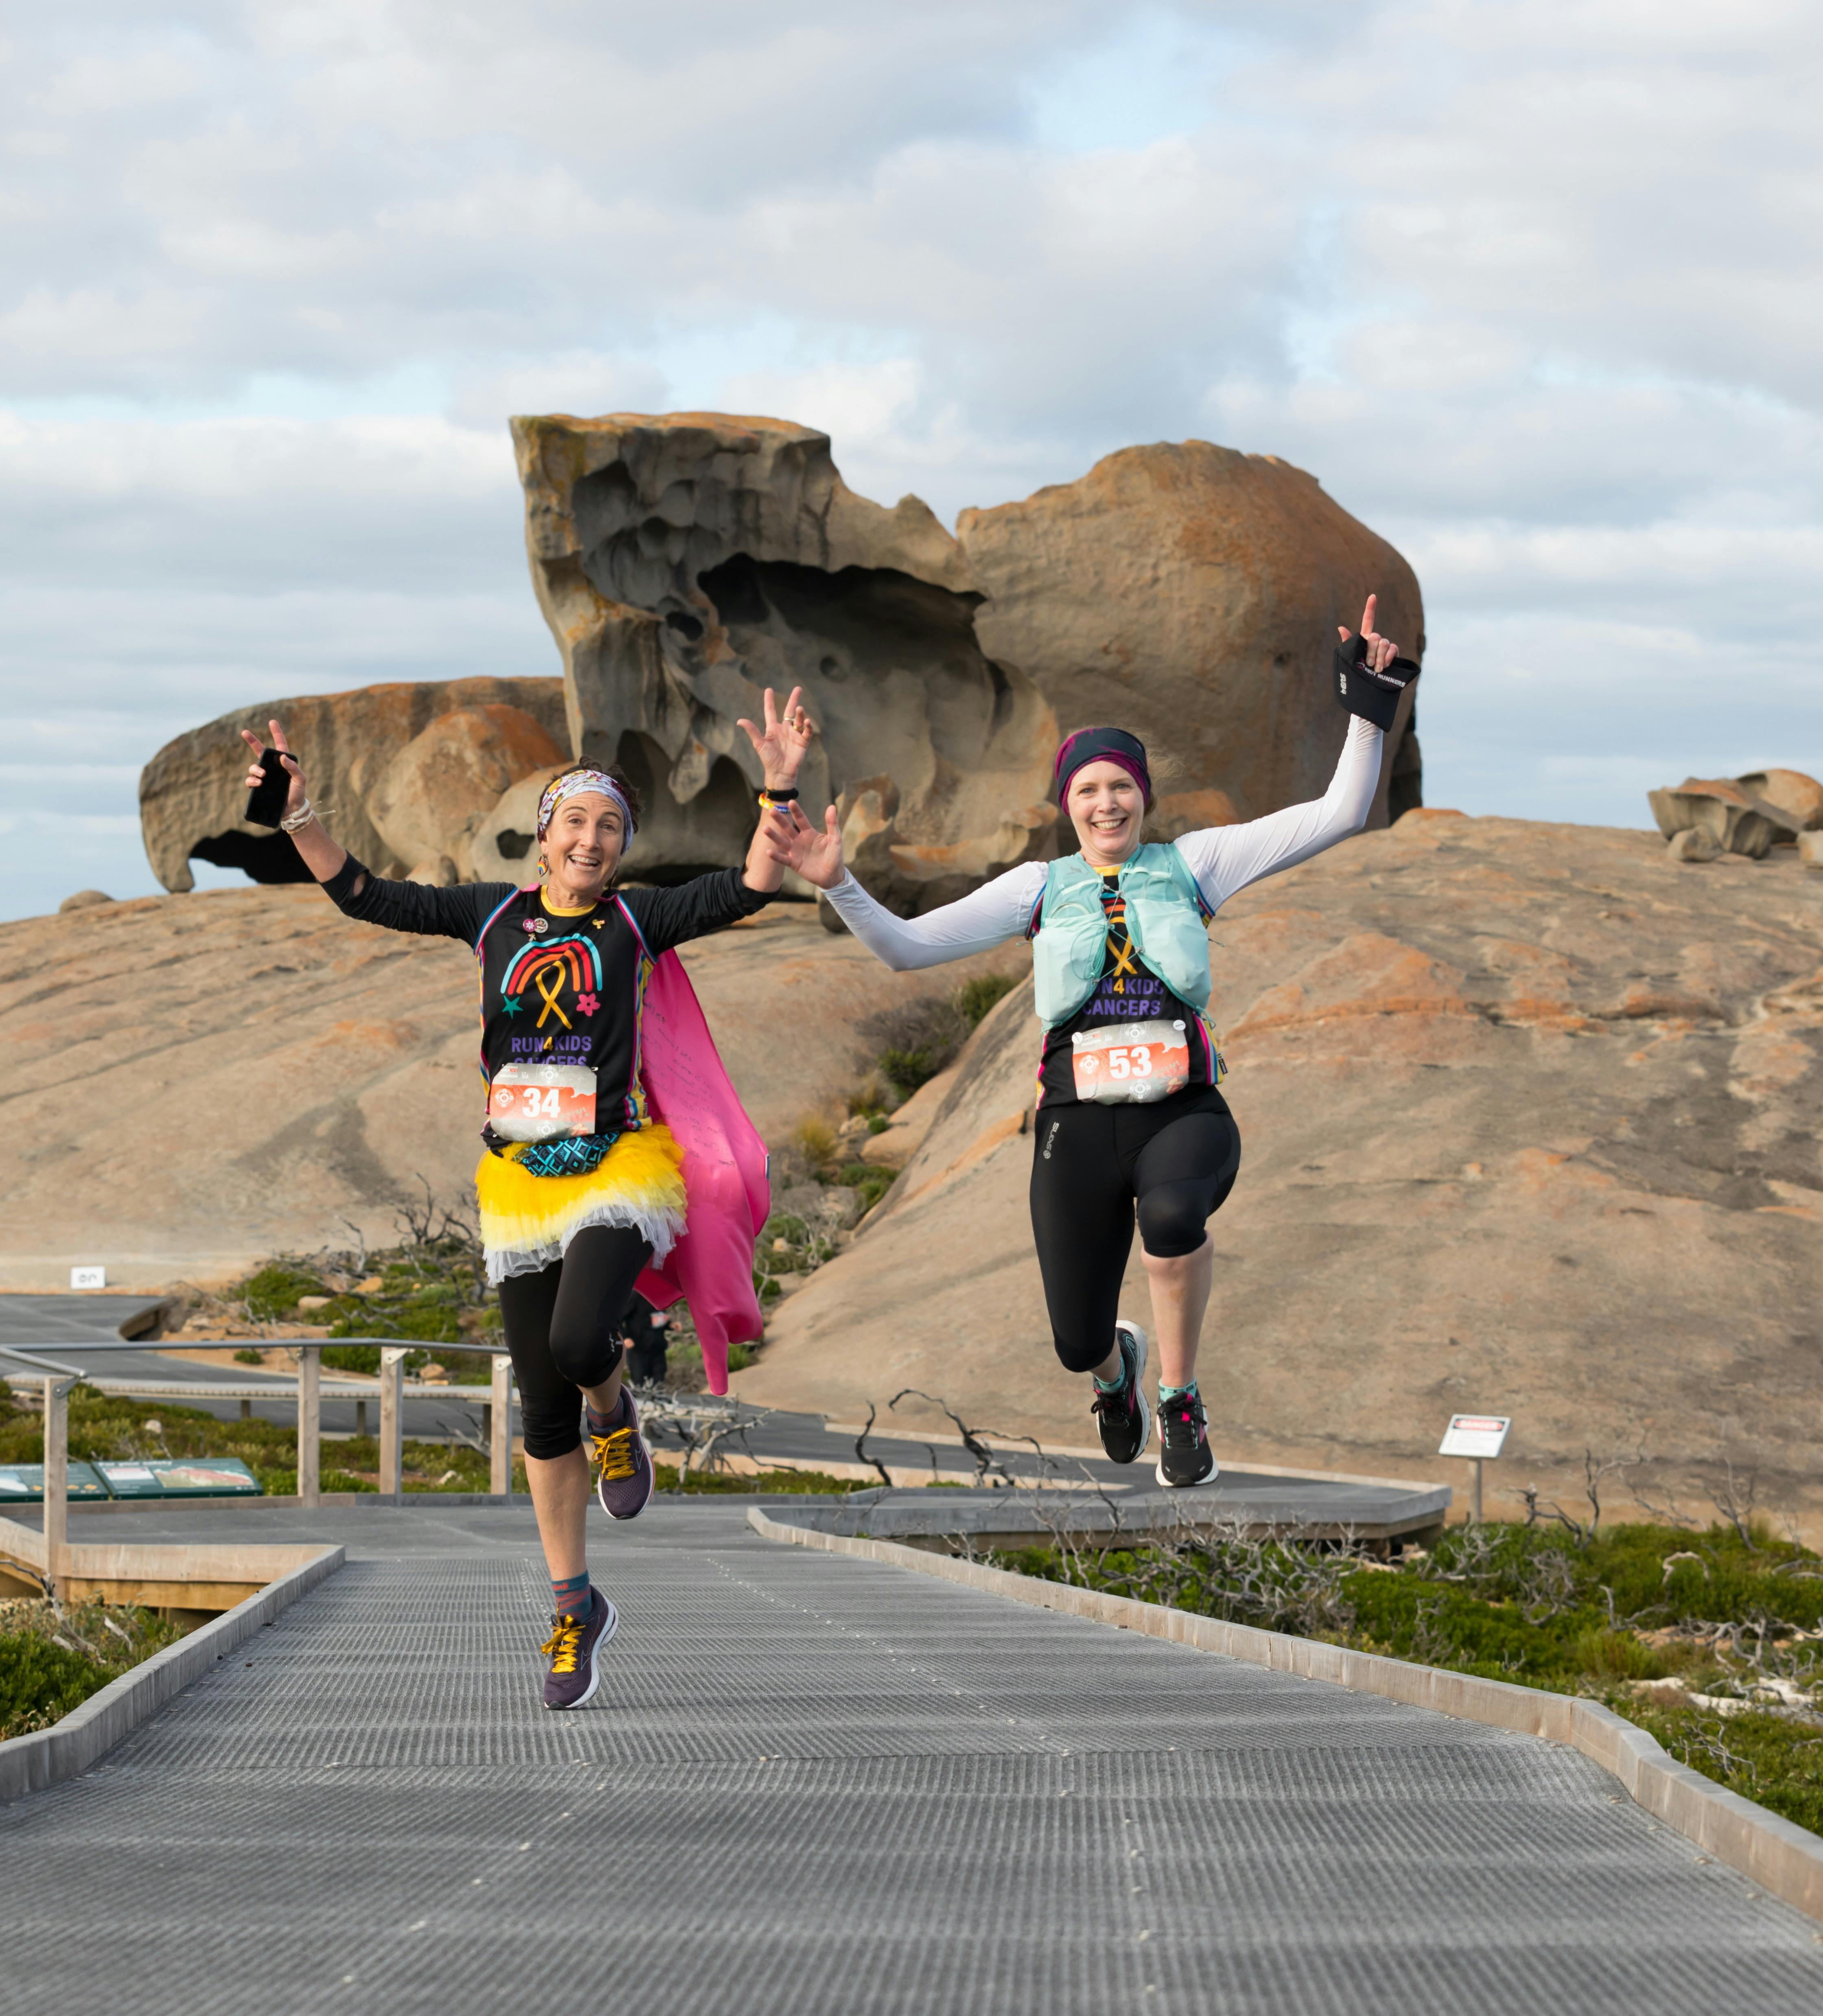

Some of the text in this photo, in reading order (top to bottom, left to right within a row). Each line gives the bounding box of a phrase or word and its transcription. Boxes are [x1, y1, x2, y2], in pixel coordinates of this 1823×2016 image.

[1364, 667, 1406, 688] RIOT RUNNERS
[1095, 978, 1164, 995] N4KIDS
[1082, 999, 1160, 1016] CANCERS
[511, 1035, 592, 1053] RUN4KIDS
[1109, 1046, 1152, 1079] 53
[522, 1087, 560, 1119] 34
[1046, 1122, 1060, 1151] SKINS
